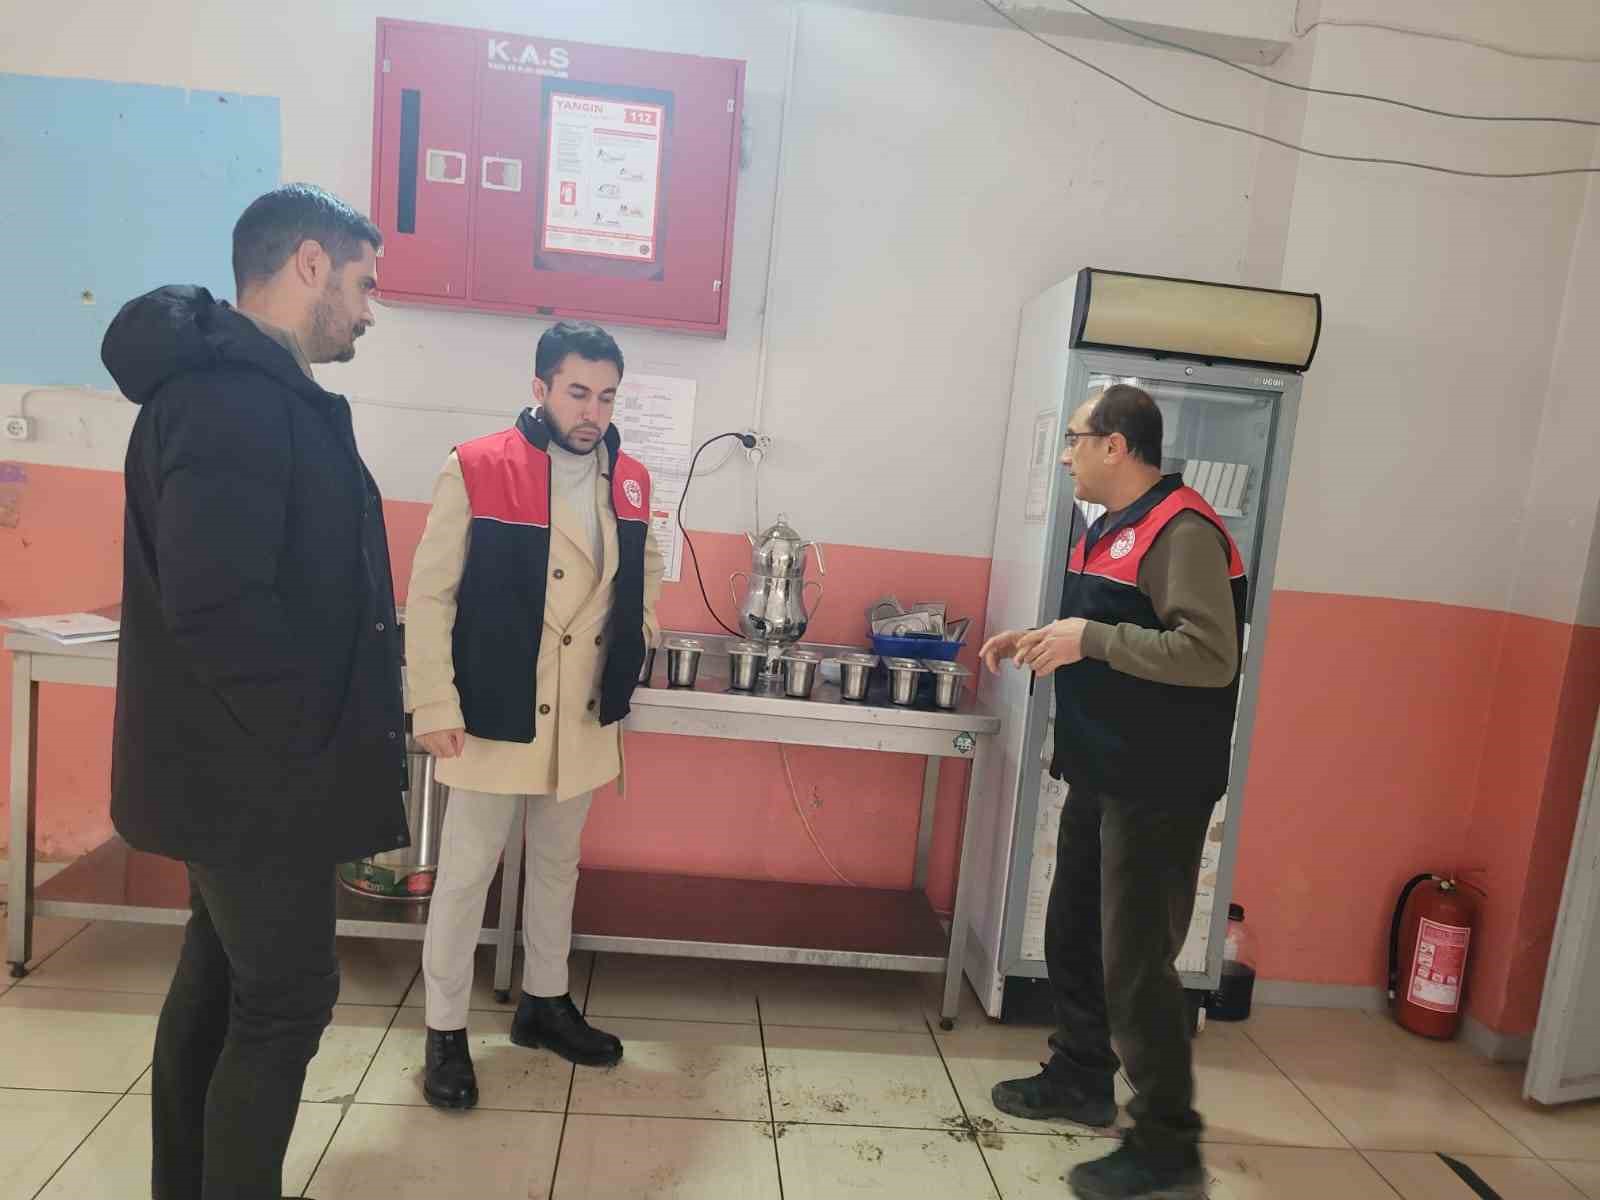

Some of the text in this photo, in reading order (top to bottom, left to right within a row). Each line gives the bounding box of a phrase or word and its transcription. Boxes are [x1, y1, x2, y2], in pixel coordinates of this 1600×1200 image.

[487, 39, 569, 65] K.A.S
[556, 100, 604, 113] YANGIN
[630, 110, 653, 124] 112
